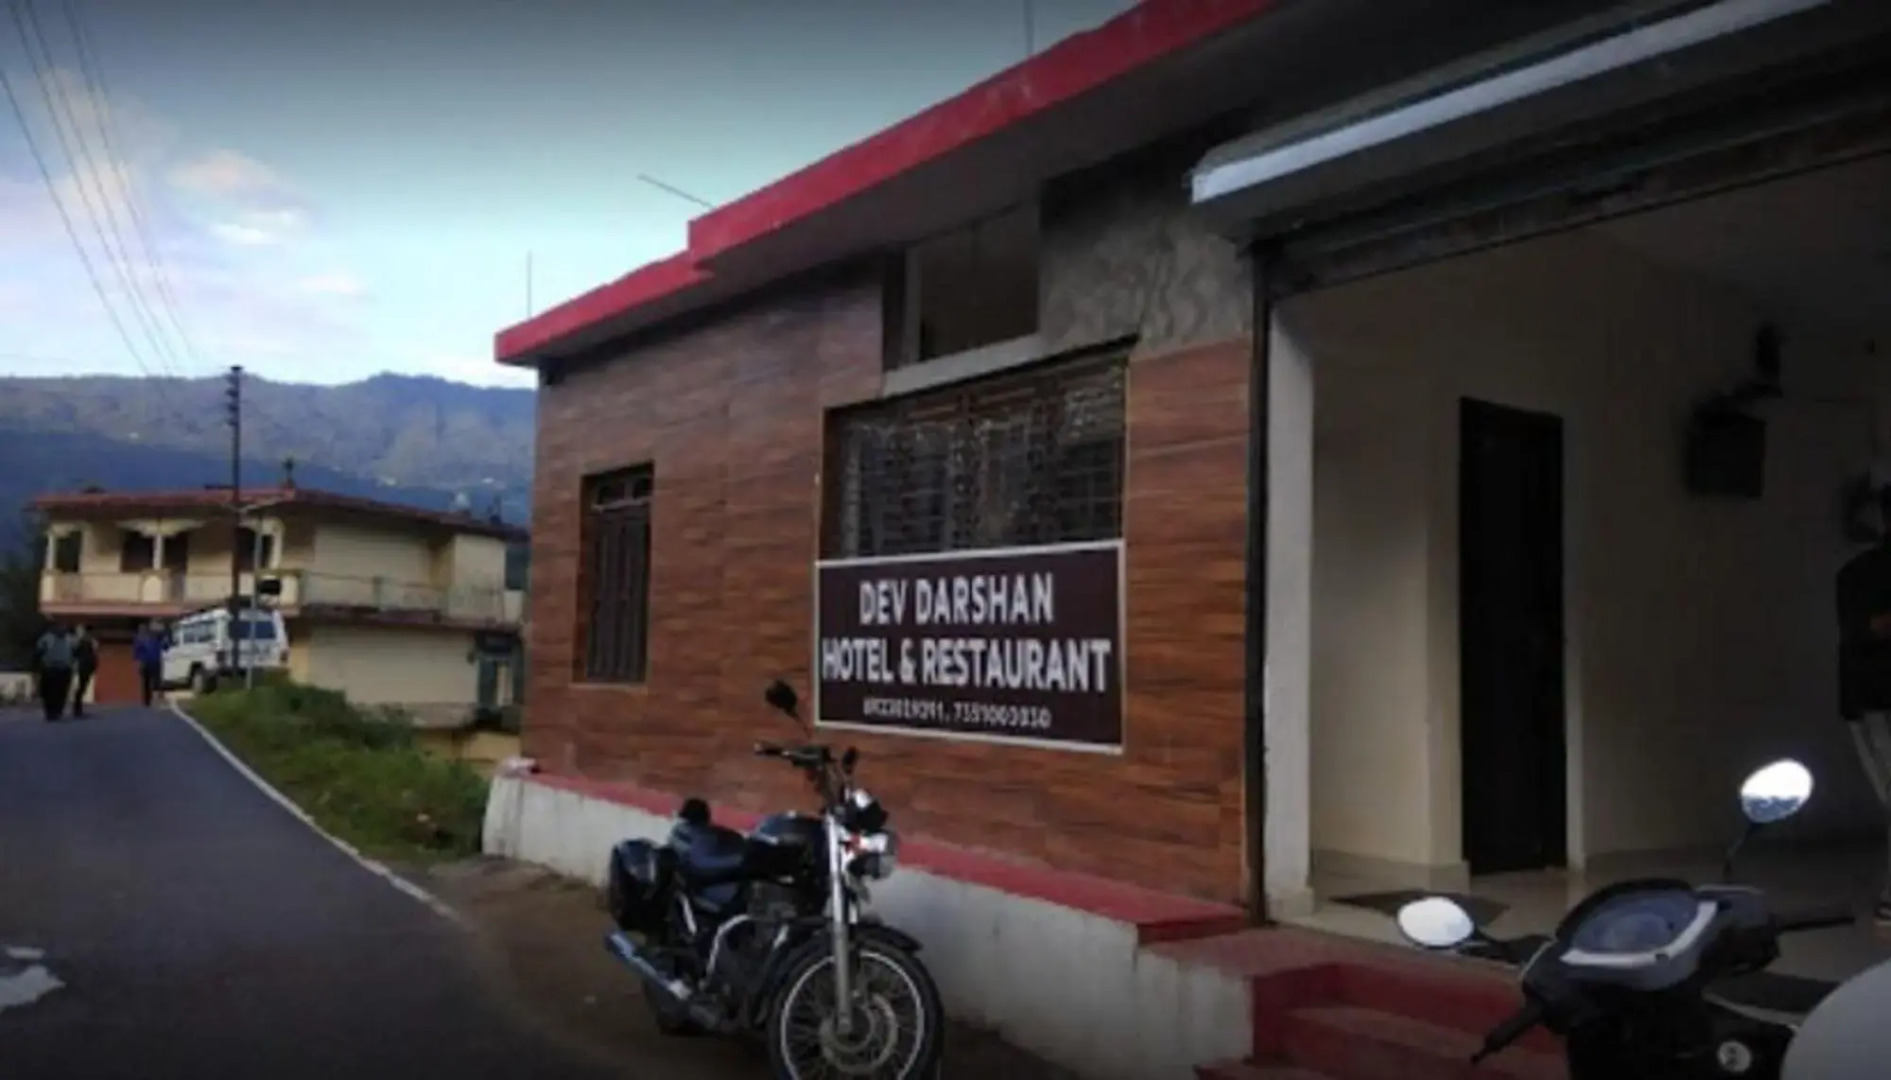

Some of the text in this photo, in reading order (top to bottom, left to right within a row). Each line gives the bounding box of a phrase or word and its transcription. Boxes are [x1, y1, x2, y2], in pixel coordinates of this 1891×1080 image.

[859, 571, 1055, 626] DEV DARSHAN
[822, 637, 1112, 693] HOTEL & RESTAURANT
